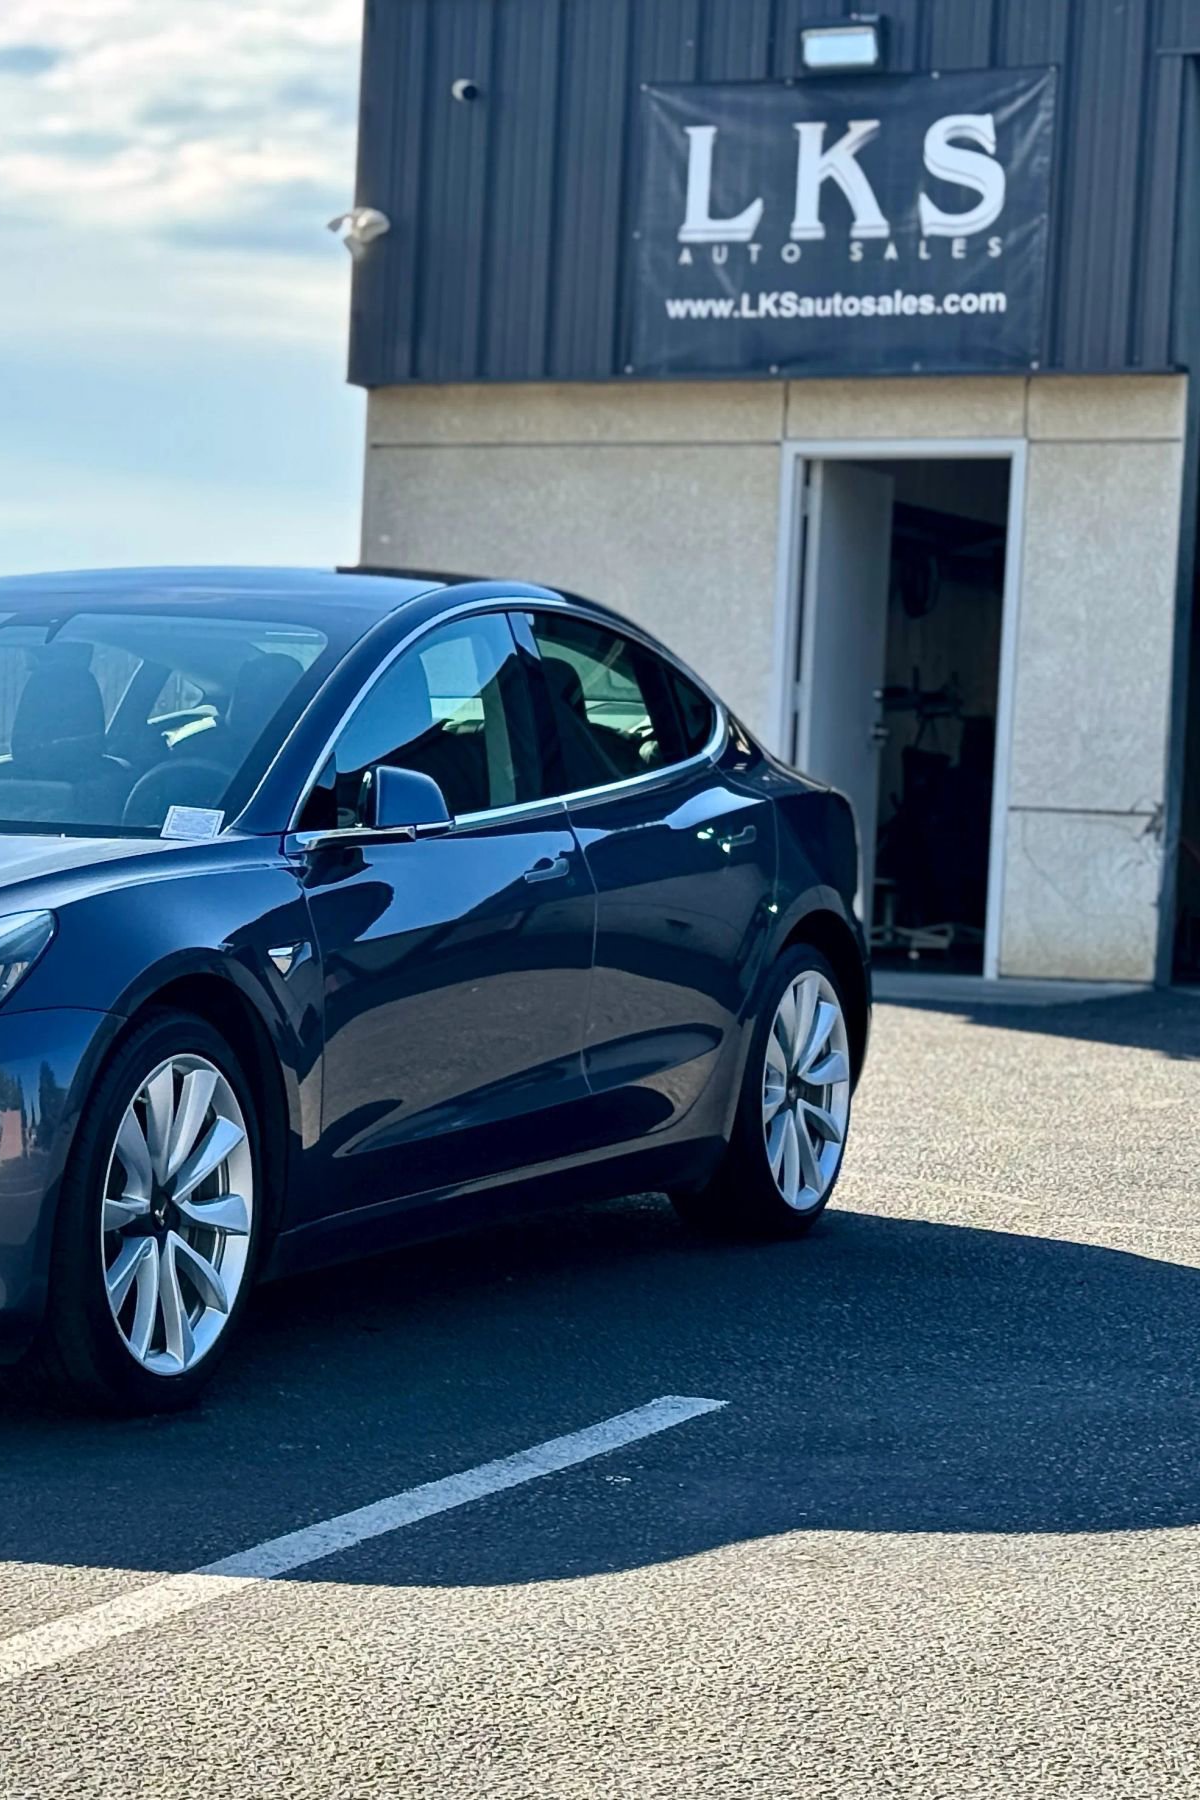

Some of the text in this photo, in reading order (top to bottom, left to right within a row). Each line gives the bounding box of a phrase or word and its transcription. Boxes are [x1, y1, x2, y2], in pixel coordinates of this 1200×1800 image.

[678, 236, 1003, 266] AUTO SALES
[665, 290, 1008, 319] www.LKSautosales.com
